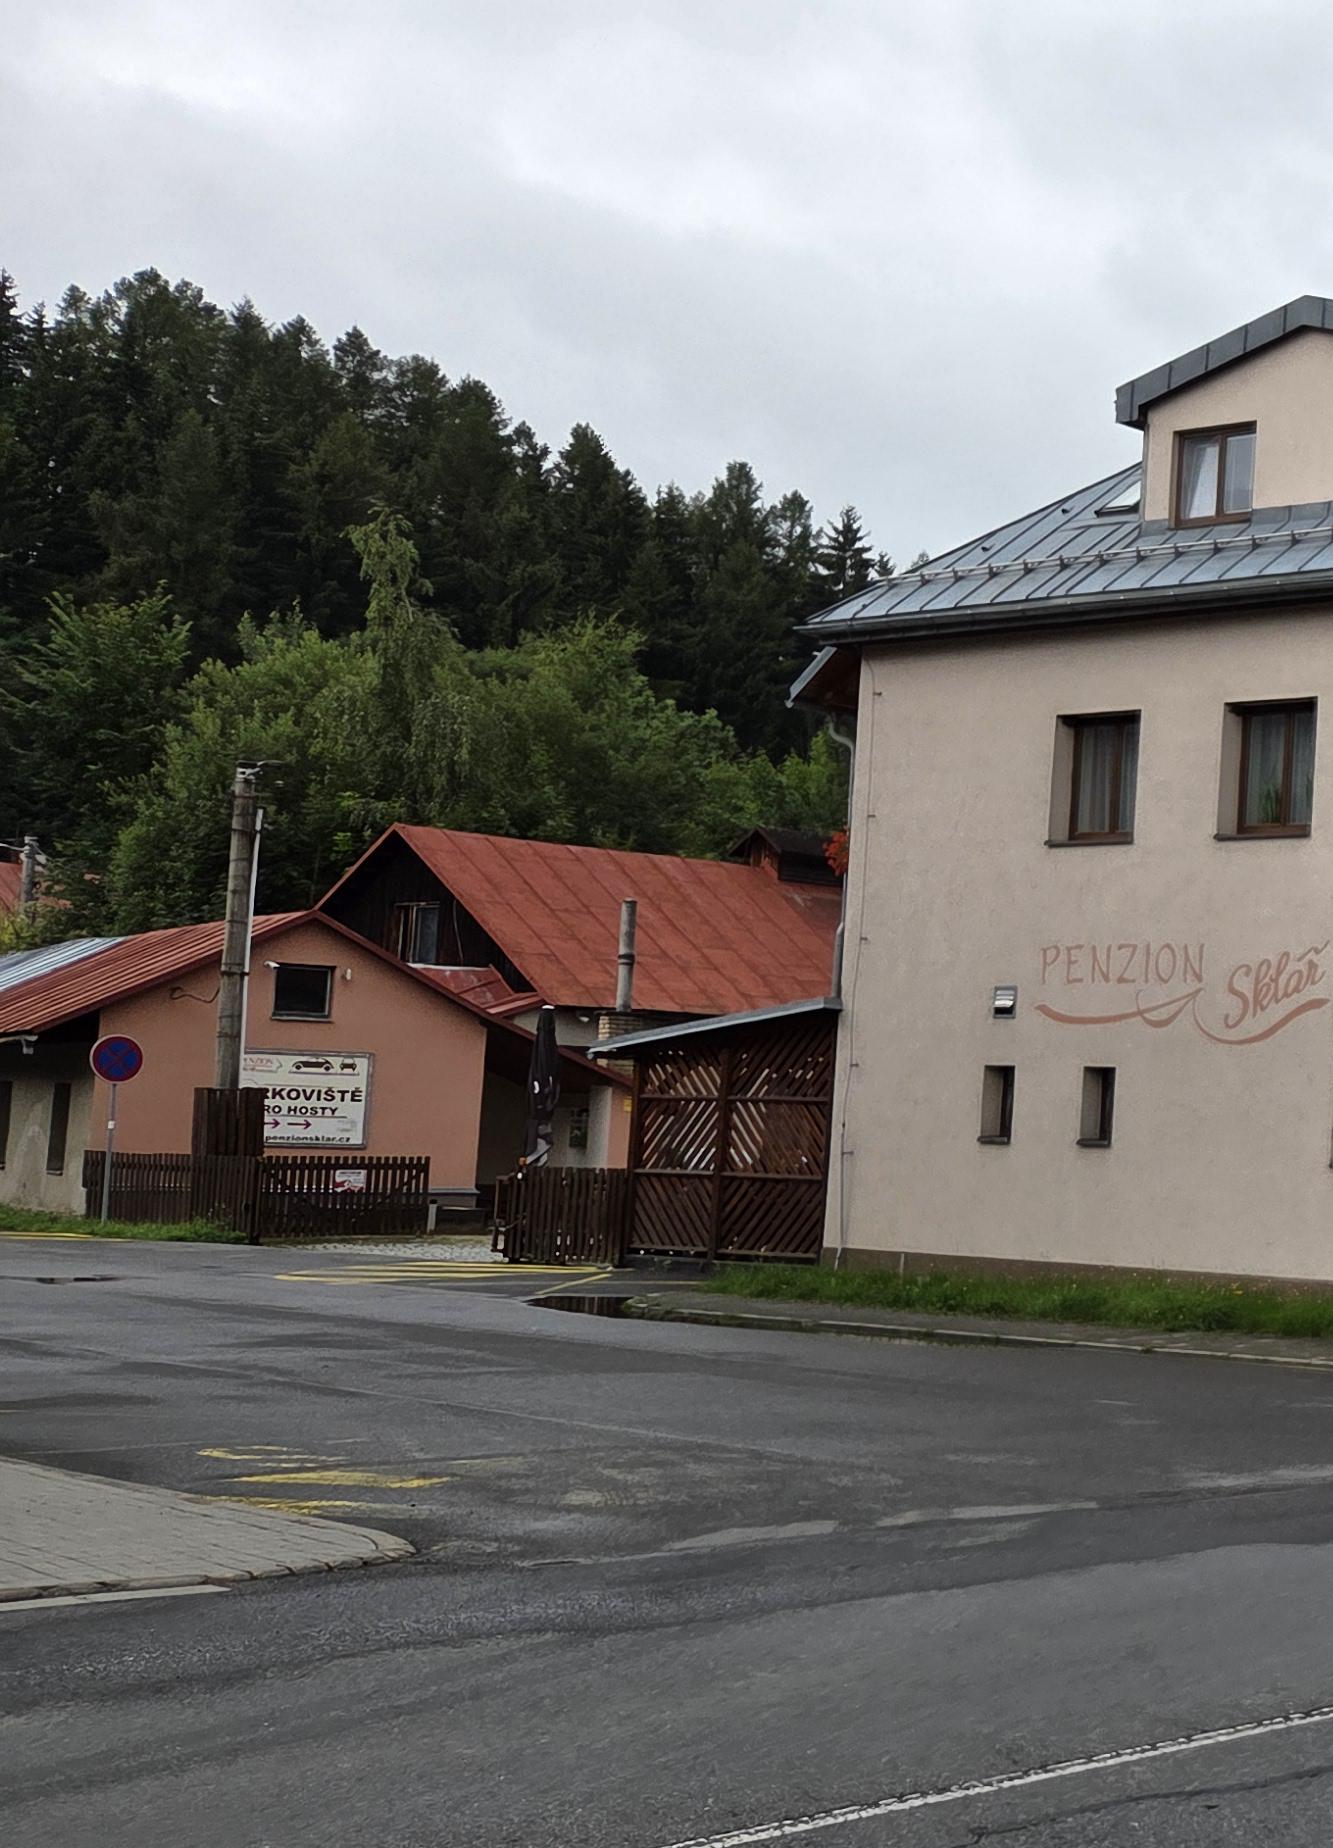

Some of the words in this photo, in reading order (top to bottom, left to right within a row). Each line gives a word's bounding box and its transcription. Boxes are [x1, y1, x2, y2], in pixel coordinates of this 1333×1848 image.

[1040, 942, 1205, 985] PENZION
[1223, 940, 1330, 1029] Sklář
[264, 1086, 363, 1103] RKOVIŠTĚ
[264, 1104, 282, 1115] RO
[287, 1105, 339, 1116] HOSTY
